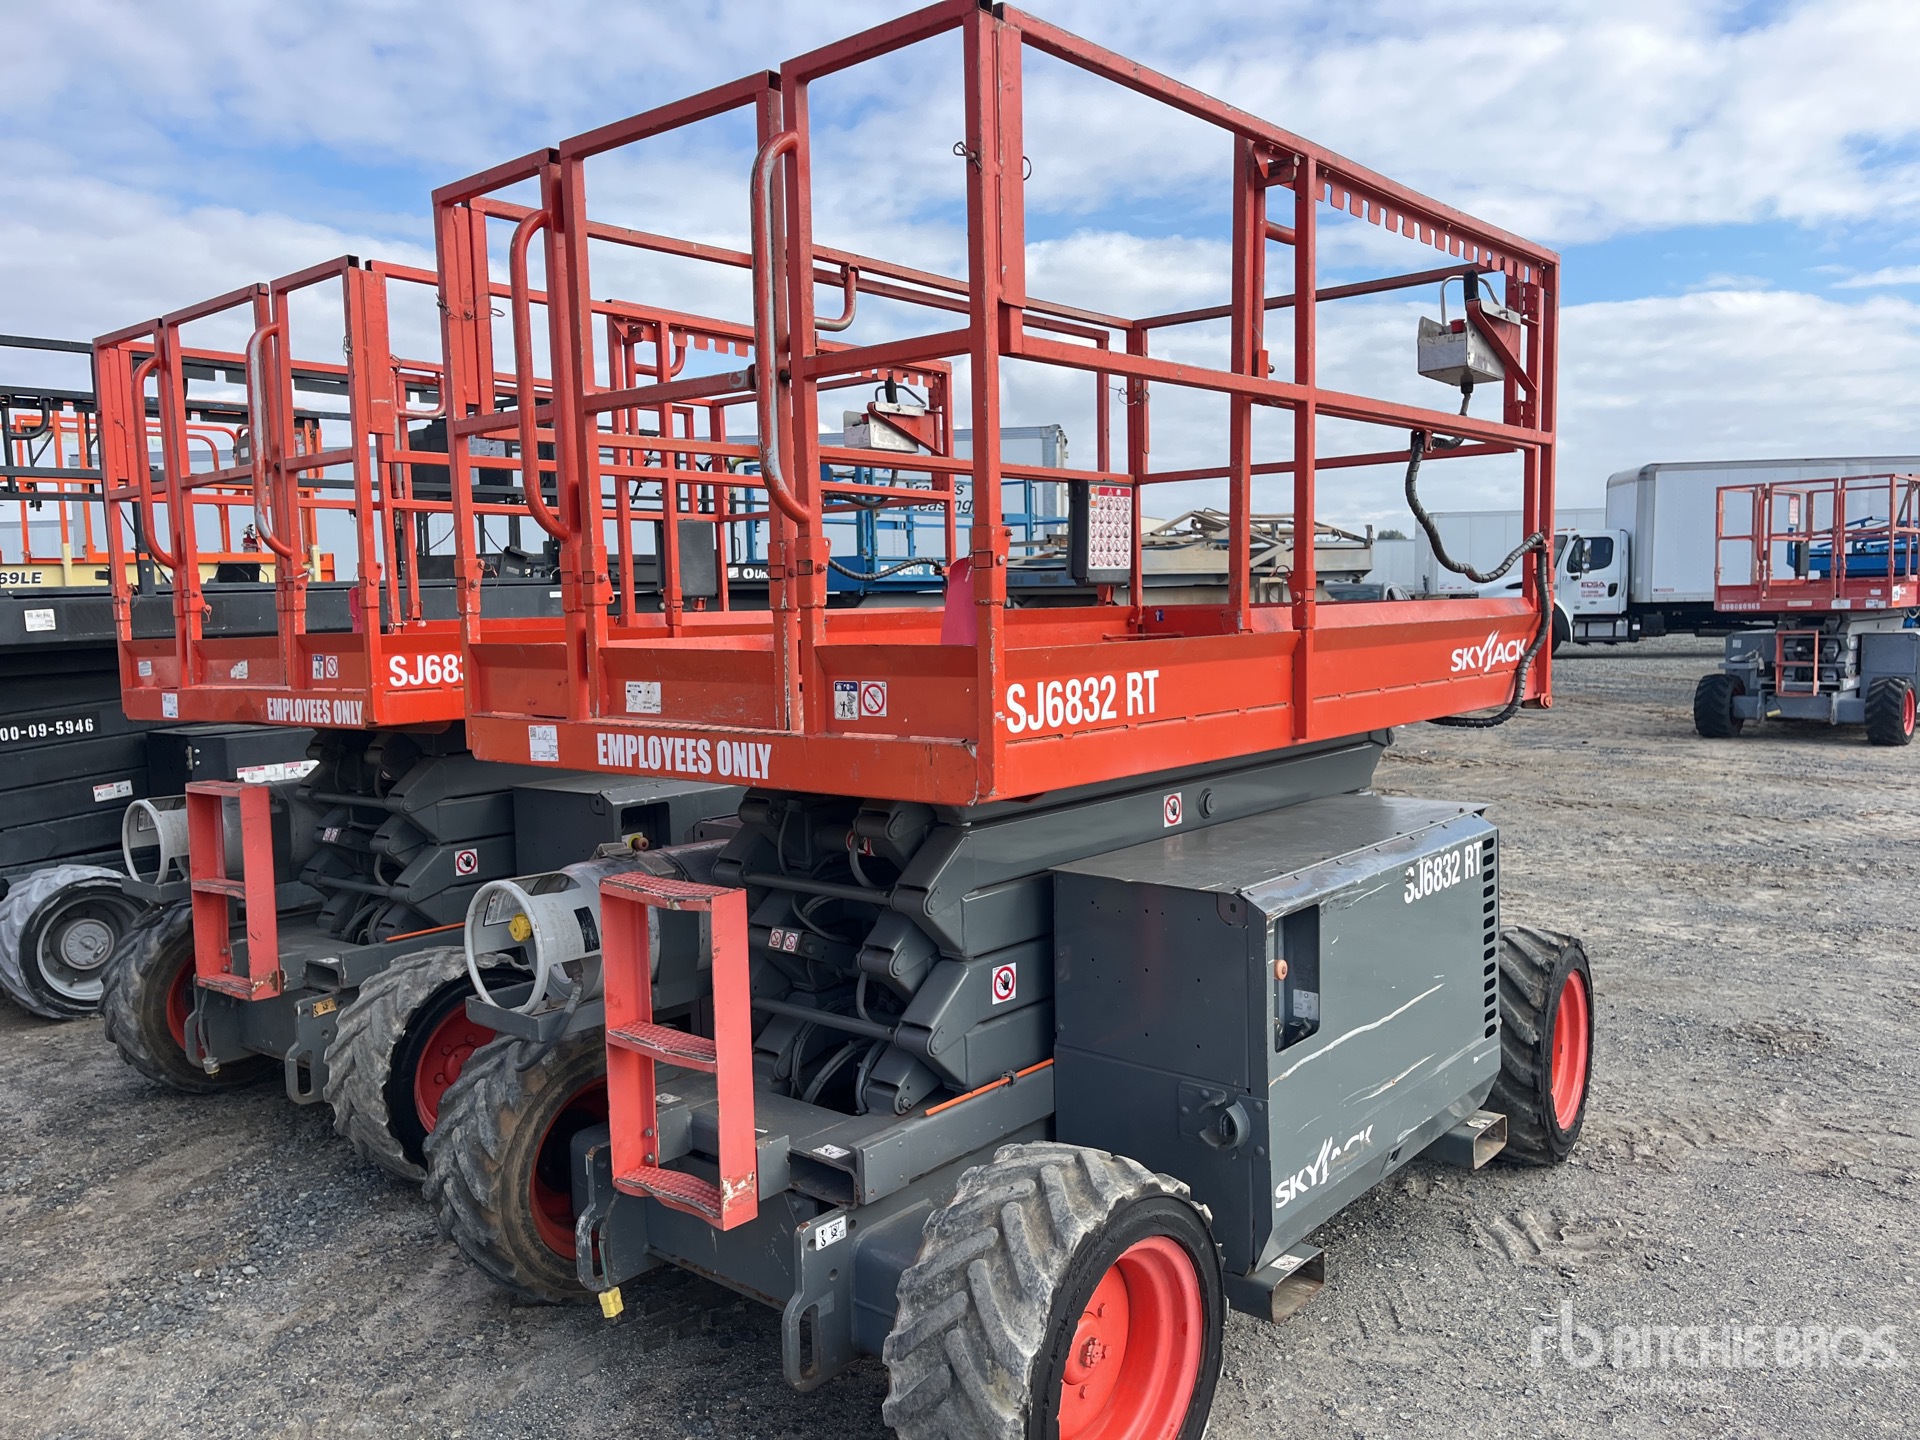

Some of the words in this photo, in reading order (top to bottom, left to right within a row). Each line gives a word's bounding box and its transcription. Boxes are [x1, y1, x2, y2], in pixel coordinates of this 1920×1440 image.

[389, 653, 464, 687] SJ68
[1450, 629, 1527, 673] SKYJACK
[266, 697, 331, 725] EMPLOYEES
[333, 699, 363, 726] ONLY
[1006, 674, 1117, 734] SJ6832
[1126, 669, 1160, 717] RT
[596, 732, 712, 775] EMPLOYEES
[717, 740, 772, 780] ONLY
[1404, 850, 1461, 904] SJ6832
[1464, 840, 1483, 880] RT
